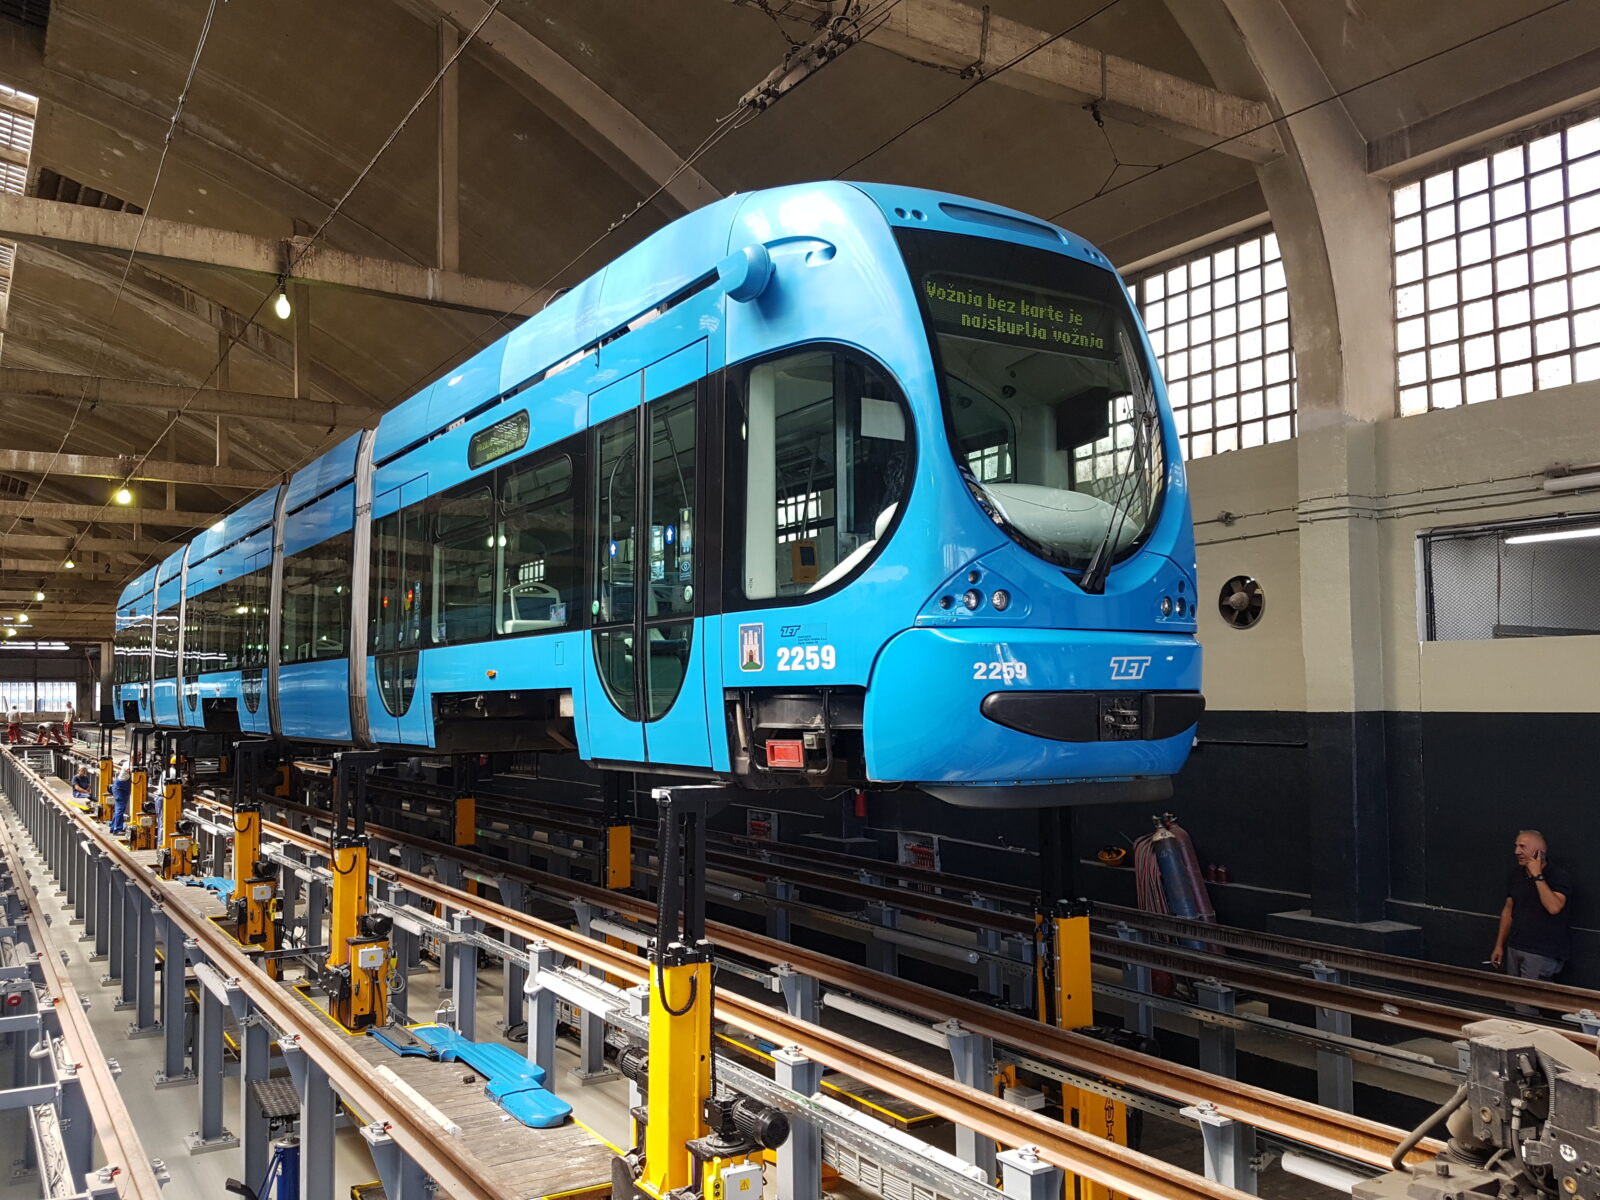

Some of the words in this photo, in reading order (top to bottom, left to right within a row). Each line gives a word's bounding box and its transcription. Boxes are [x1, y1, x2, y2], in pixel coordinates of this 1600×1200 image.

[926, 281, 983, 307] Vožnja
[987, 293, 1016, 313] bez
[1020, 299, 1064, 322] karte
[1068, 308, 1083, 326] je
[961, 313, 1047, 340] najskuplja
[1052, 328, 1104, 349] vožnja
[780, 625, 801, 638] ZET
[776, 645, 836, 671] 2259
[1110, 656, 1151, 680] ZET
[973, 662, 1027, 680] 2259
